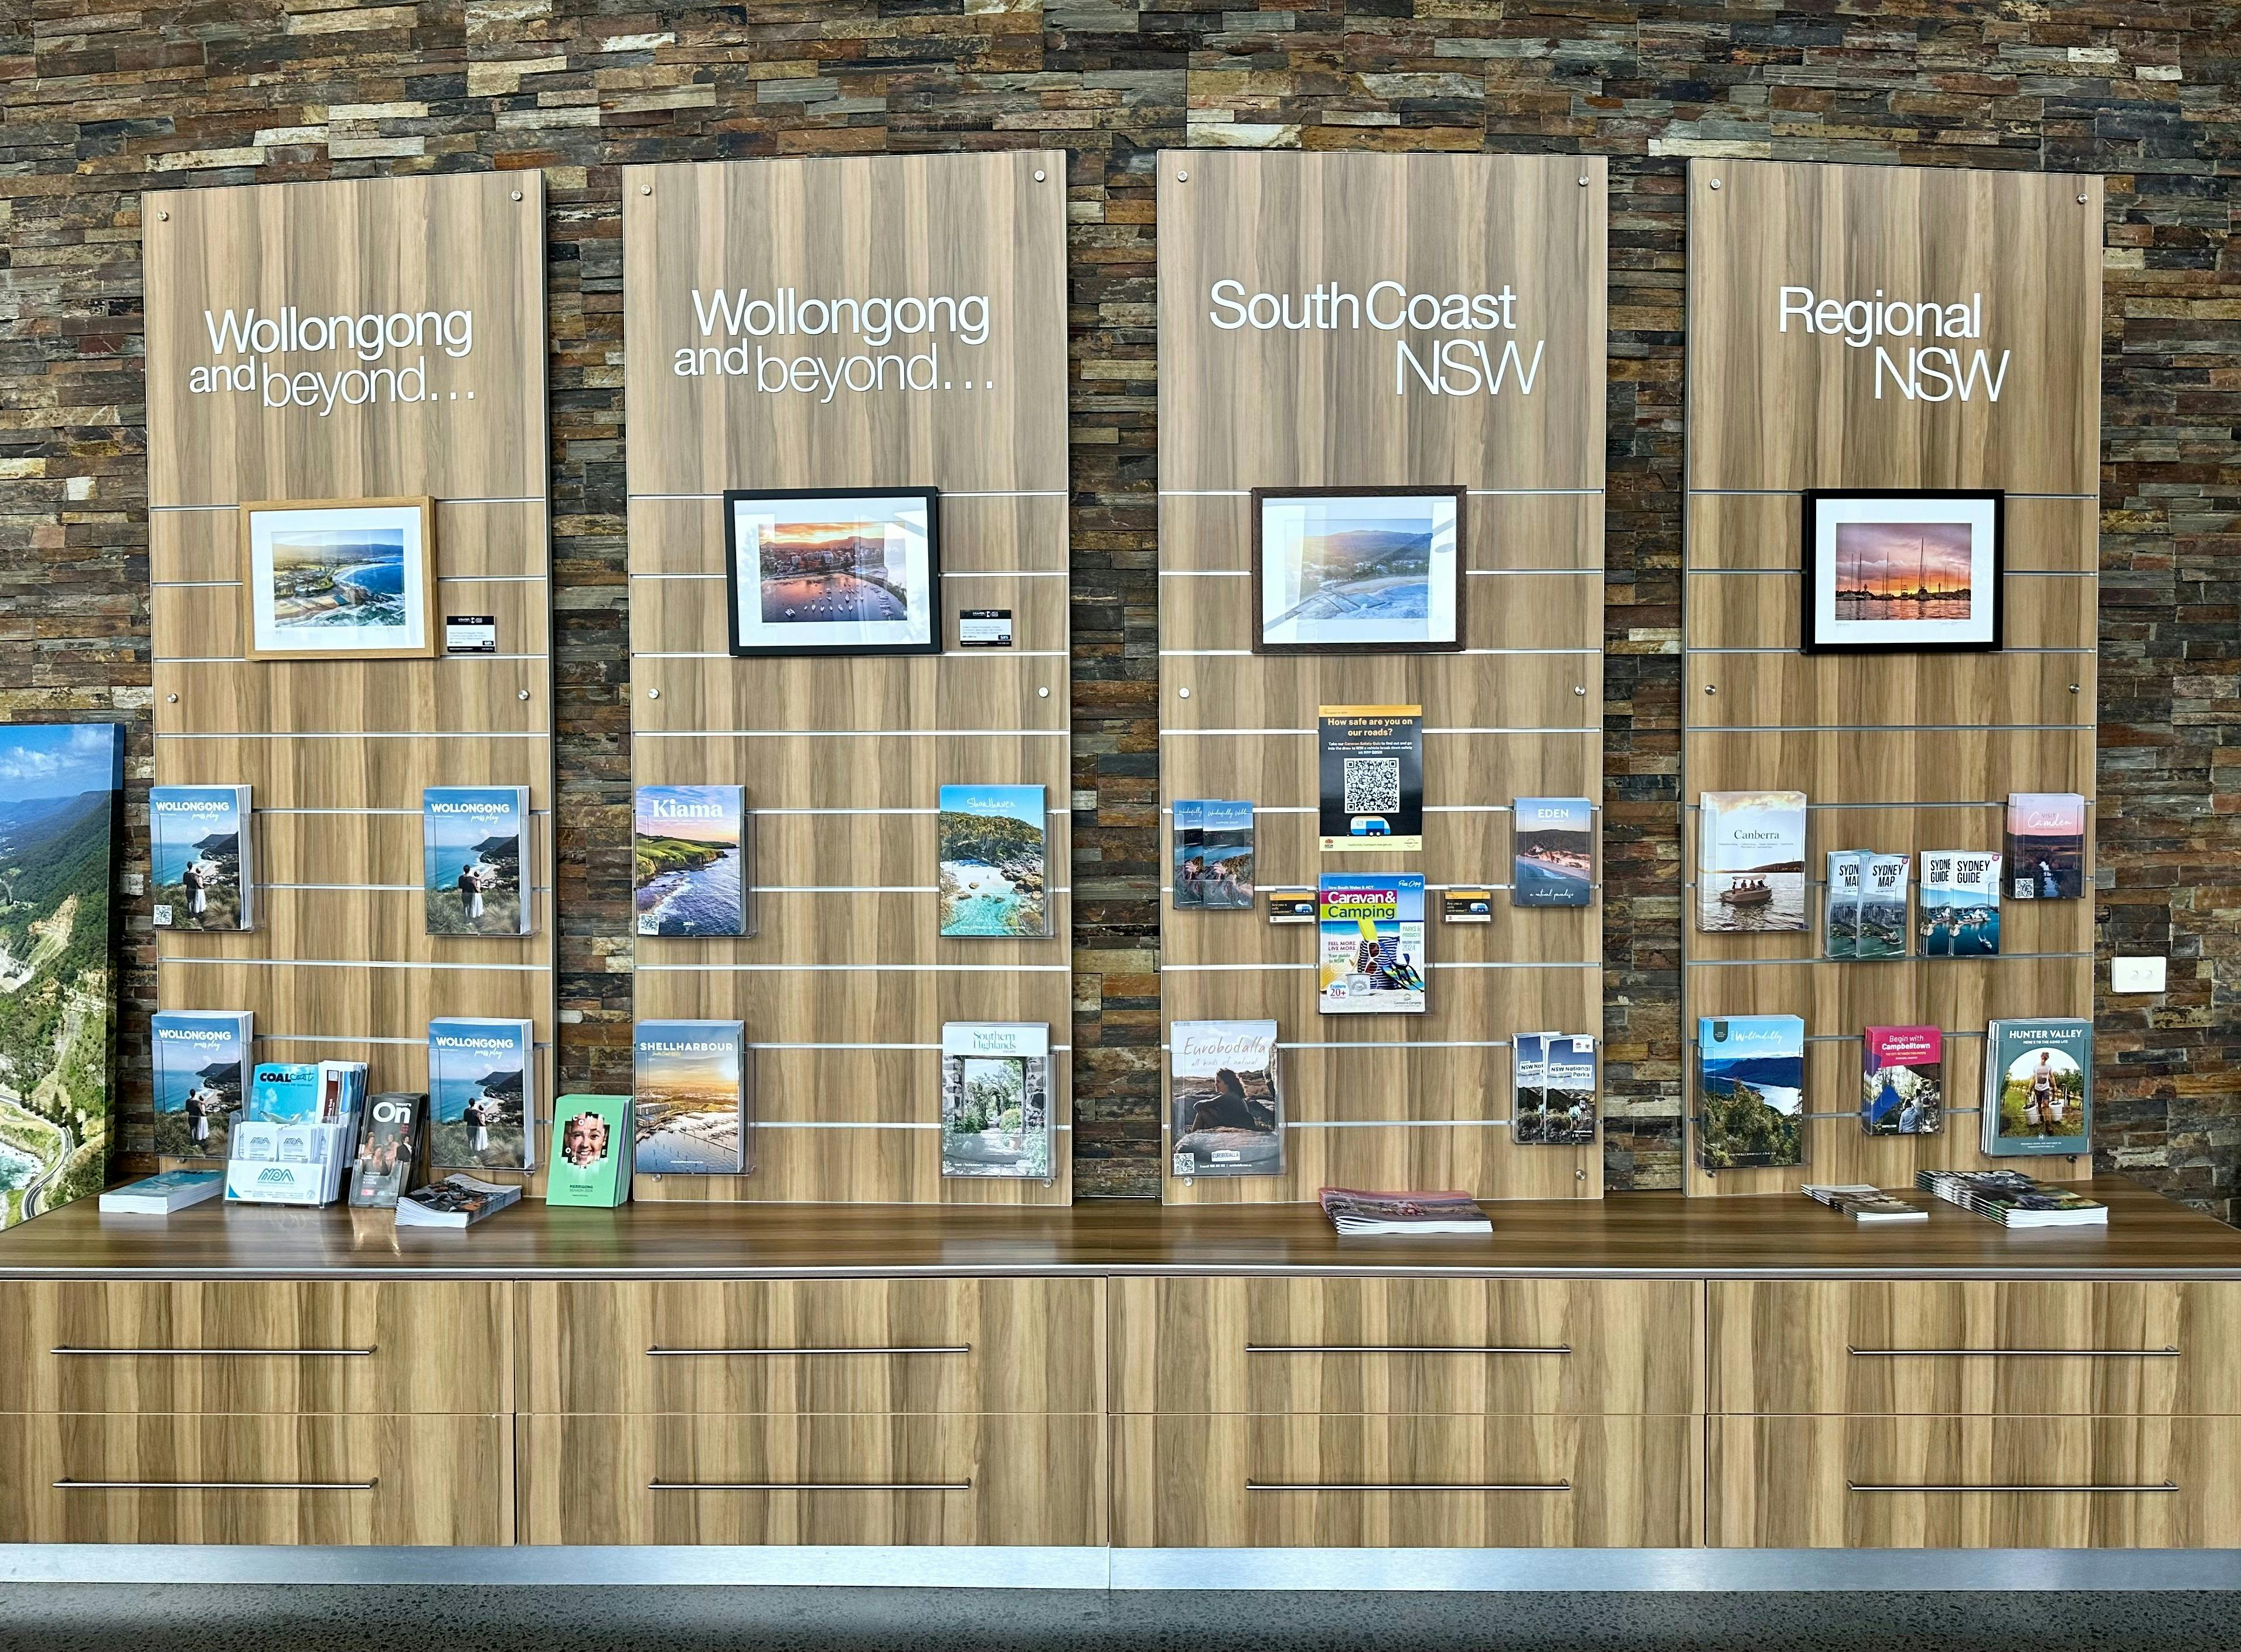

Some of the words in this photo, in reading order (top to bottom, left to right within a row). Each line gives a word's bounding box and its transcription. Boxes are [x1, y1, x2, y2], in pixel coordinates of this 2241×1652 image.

[1209, 279, 1360, 331] South
[1365, 280, 1517, 331] Coast
[691, 287, 990, 347] Wollongong
[1779, 285, 1981, 348] Regional
[204, 306, 473, 362] Wollongong
[673, 338, 748, 377] and
[1396, 338, 1545, 397] NSW
[189, 355, 257, 393] and
[1875, 346, 2011, 403] NSW
[1364, 728, 1393, 736] roads?
[155, 801, 230, 812] WOLLONGONG
[431, 803, 510, 813] WOLLONGONG
[652, 798, 724, 818] Kiama
[1538, 809, 1569, 818] EDEN
[2027, 811, 2072, 827] Camden
[1734, 829, 1779, 839] Canberra
[1839, 864, 1859, 876] SYDN
[1872, 864, 1903, 877] SYDNEY
[1930, 859, 1951, 871] SYDNE
[1957, 860, 1990, 871] SYDNEY
[1878, 876, 1895, 887] MAP
[1930, 870, 1949, 883] GUIDE
[1957, 872, 1981, 883] GUIDE
[1328, 891, 1384, 904] Caravan
[1385, 891, 1396, 904] &
[1328, 905, 1395, 919] Camping
[1330, 988, 1346, 996] 20+
[158, 1029, 231, 1040] WOLLONGONG
[973, 1031, 1015, 1041] Southern
[1889, 1034, 1908, 1044] Begin
[2009, 1030, 2048, 1039] HUNTER
[2049, 1029, 2082, 1038] VALLEY
[435, 1037, 514, 1048] WOLLONGONG
[640, 1042, 733, 1051] SHELLHARBOUR
[973, 1040, 1016, 1051] Highlands
[1184, 1036, 1266, 1055] Eurobodalla
[1882, 1042, 1931, 1051] Campbelltown
[260, 1072, 291, 1082] COAL
[373, 1101, 411, 1124] On
